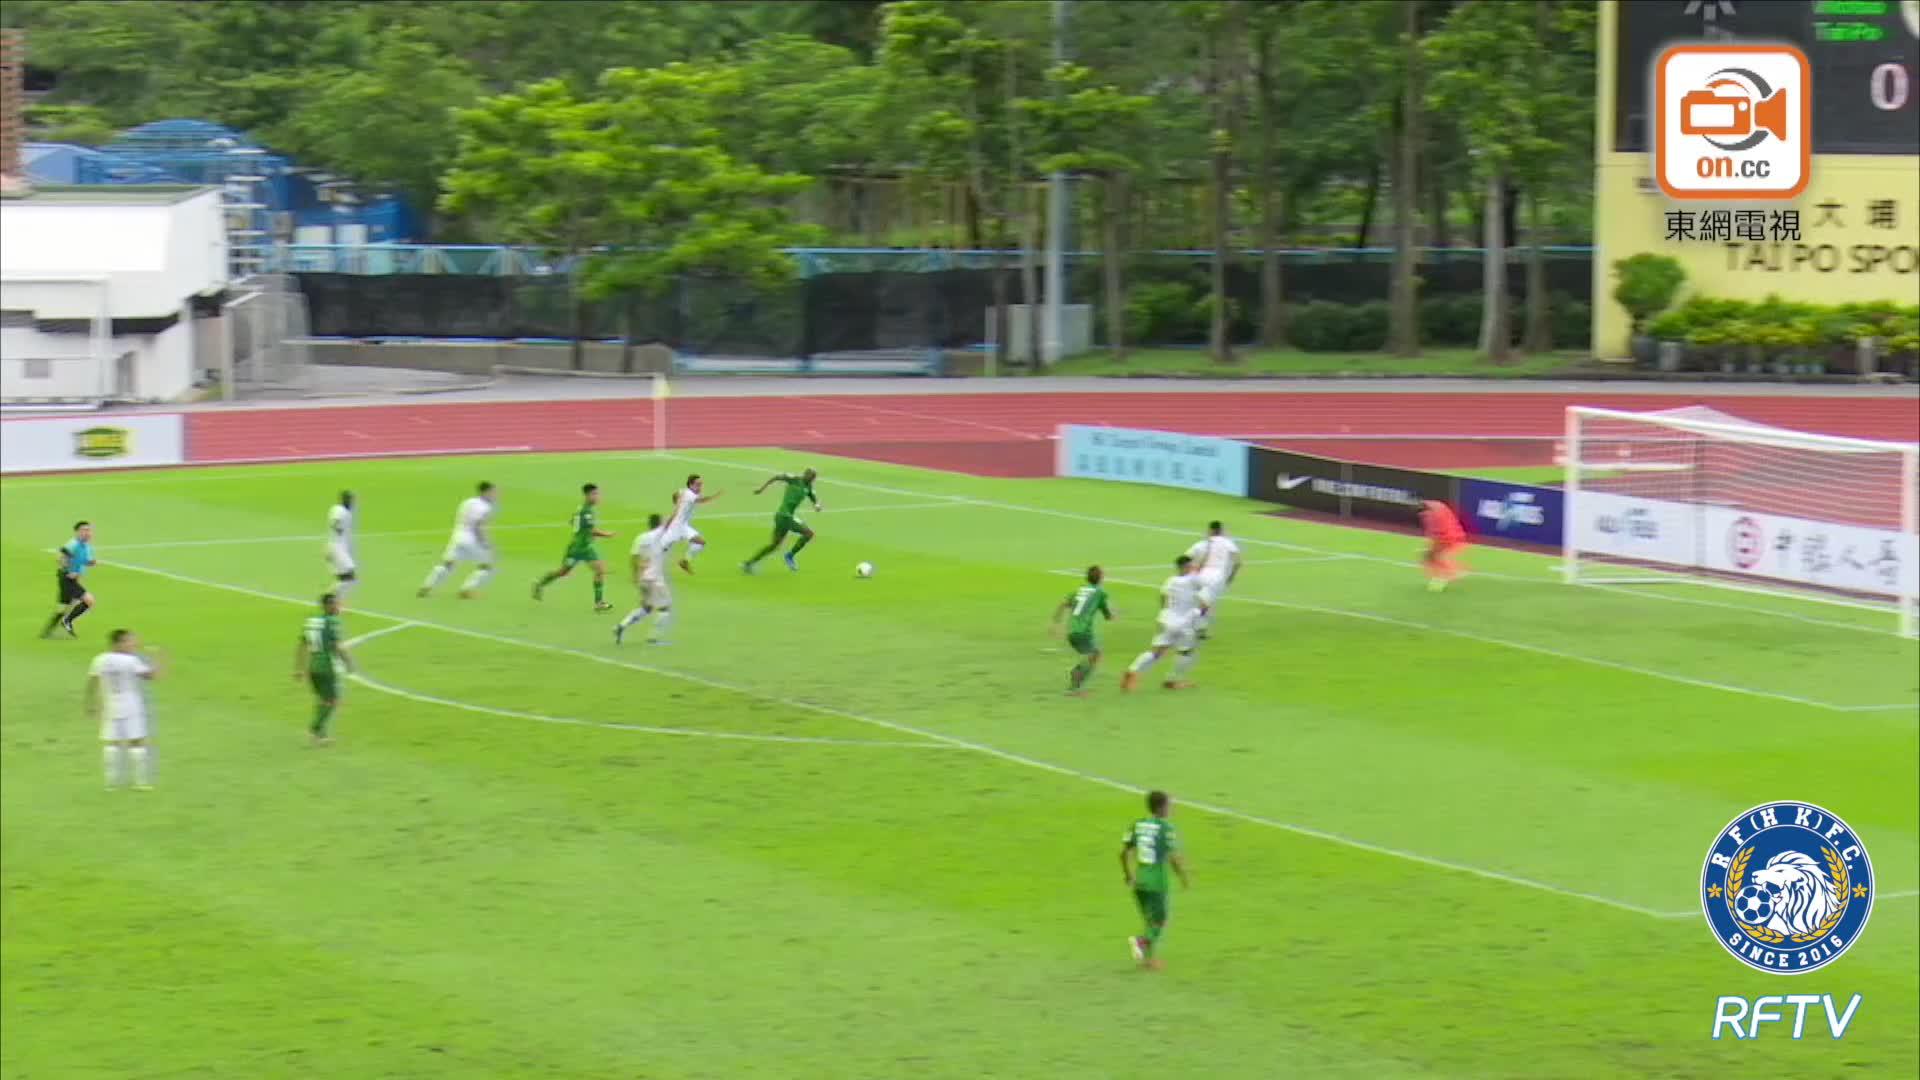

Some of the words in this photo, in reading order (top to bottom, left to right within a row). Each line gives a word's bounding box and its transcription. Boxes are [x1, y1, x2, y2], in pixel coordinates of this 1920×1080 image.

[1870, 63, 1910, 110] 0
[1724, 242, 1782, 271] TAI
[1790, 244, 1840, 272] PO
